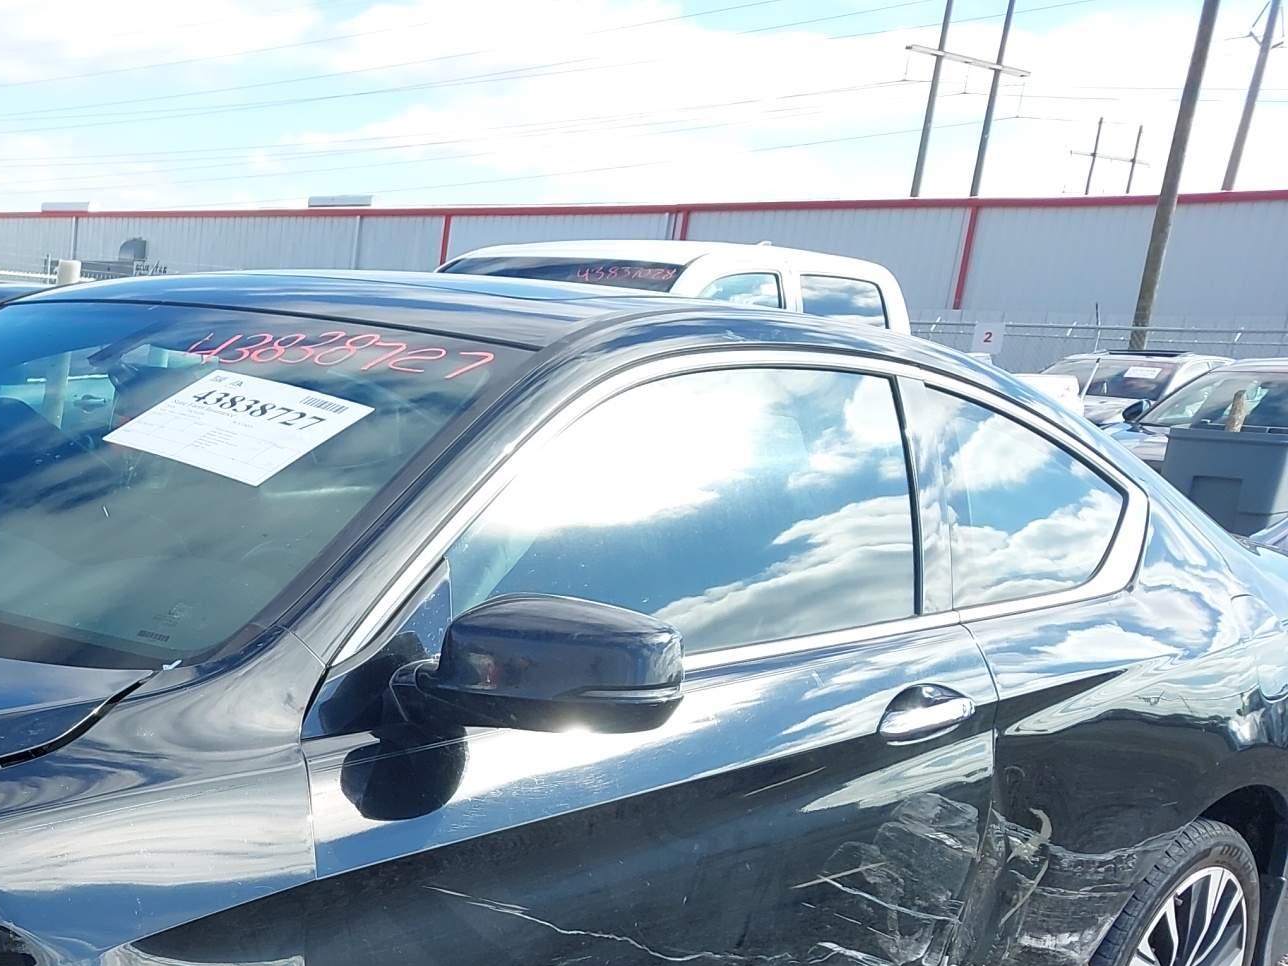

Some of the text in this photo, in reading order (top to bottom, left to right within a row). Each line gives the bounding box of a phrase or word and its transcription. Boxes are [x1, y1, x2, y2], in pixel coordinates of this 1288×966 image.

[185, 331, 495, 379] 43838727
[983, 331, 993, 343] 2
[192, 389, 327, 431] 43838727
